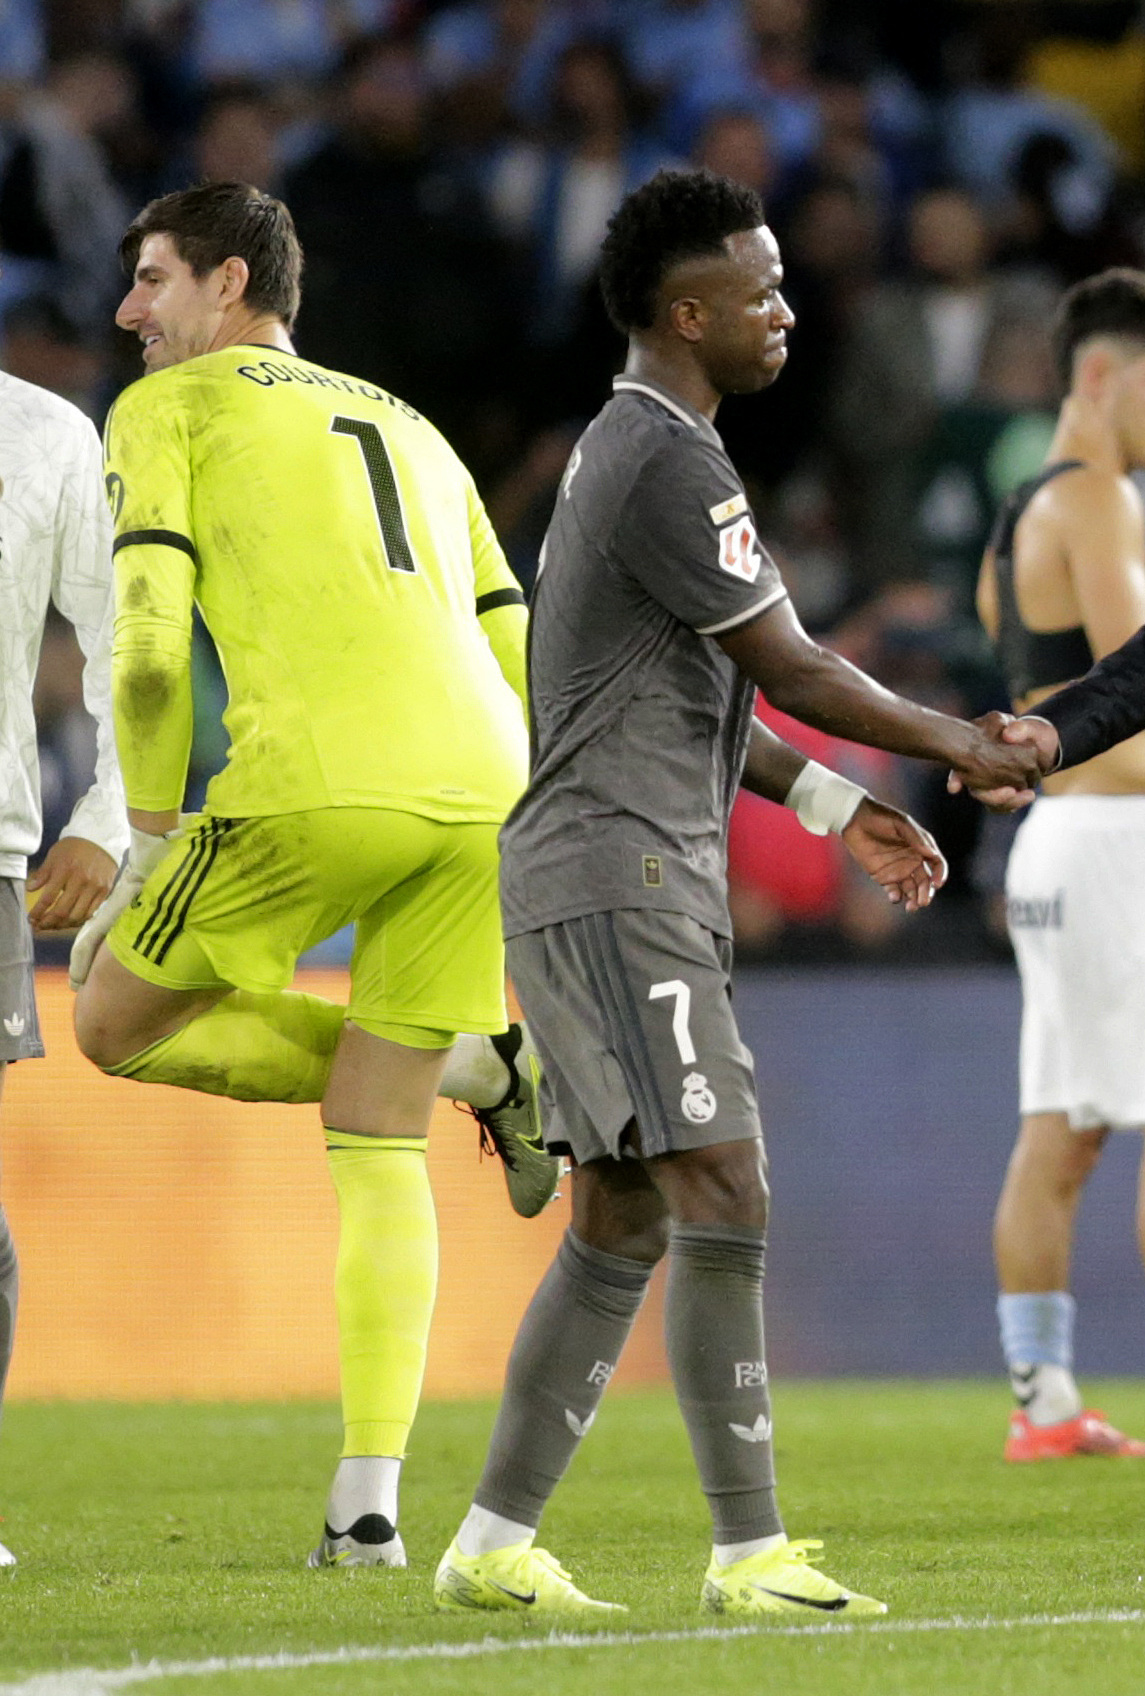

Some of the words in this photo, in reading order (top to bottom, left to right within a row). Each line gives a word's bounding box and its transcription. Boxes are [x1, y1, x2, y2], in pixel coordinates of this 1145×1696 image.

[237, 361, 420, 421] COURTOIS
[330, 414, 418, 573] 1
[648, 979, 697, 1066] 7
